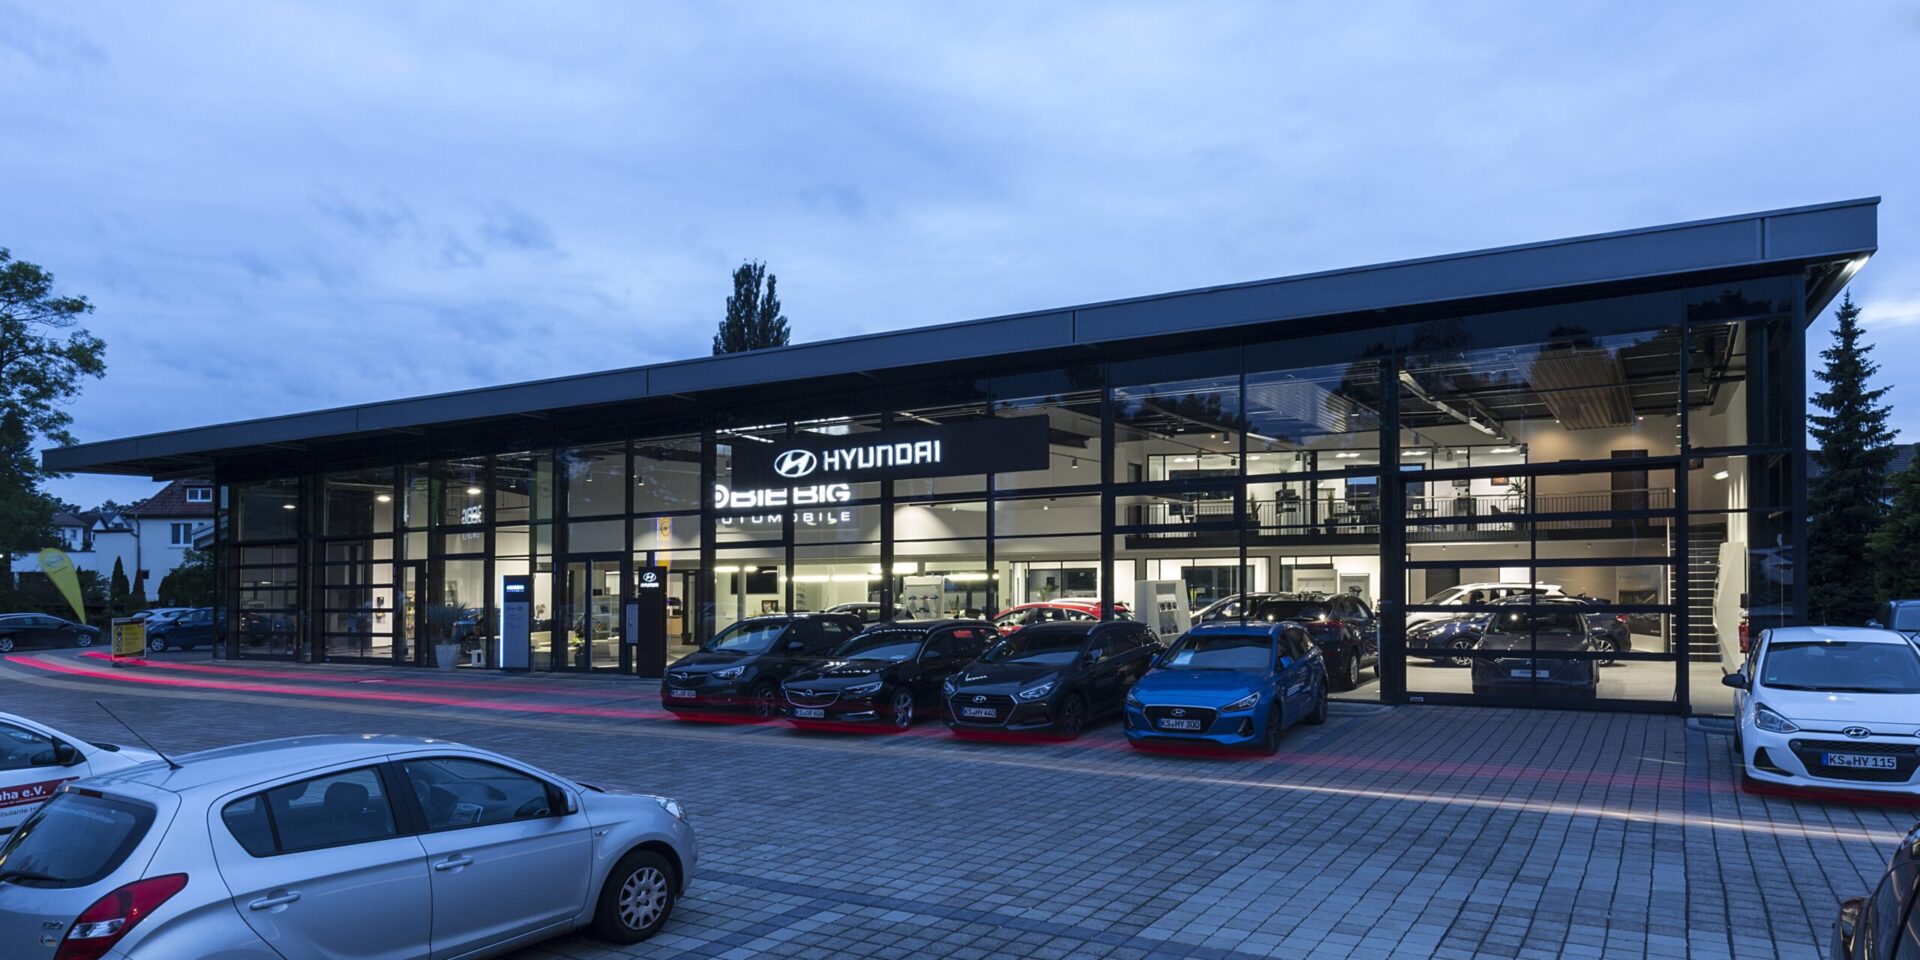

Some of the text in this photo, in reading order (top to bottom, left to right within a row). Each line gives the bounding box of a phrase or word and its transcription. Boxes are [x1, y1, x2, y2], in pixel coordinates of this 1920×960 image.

[823, 440, 941, 471] HYUNDAI
[1829, 755, 1895, 768] KS HY 115
